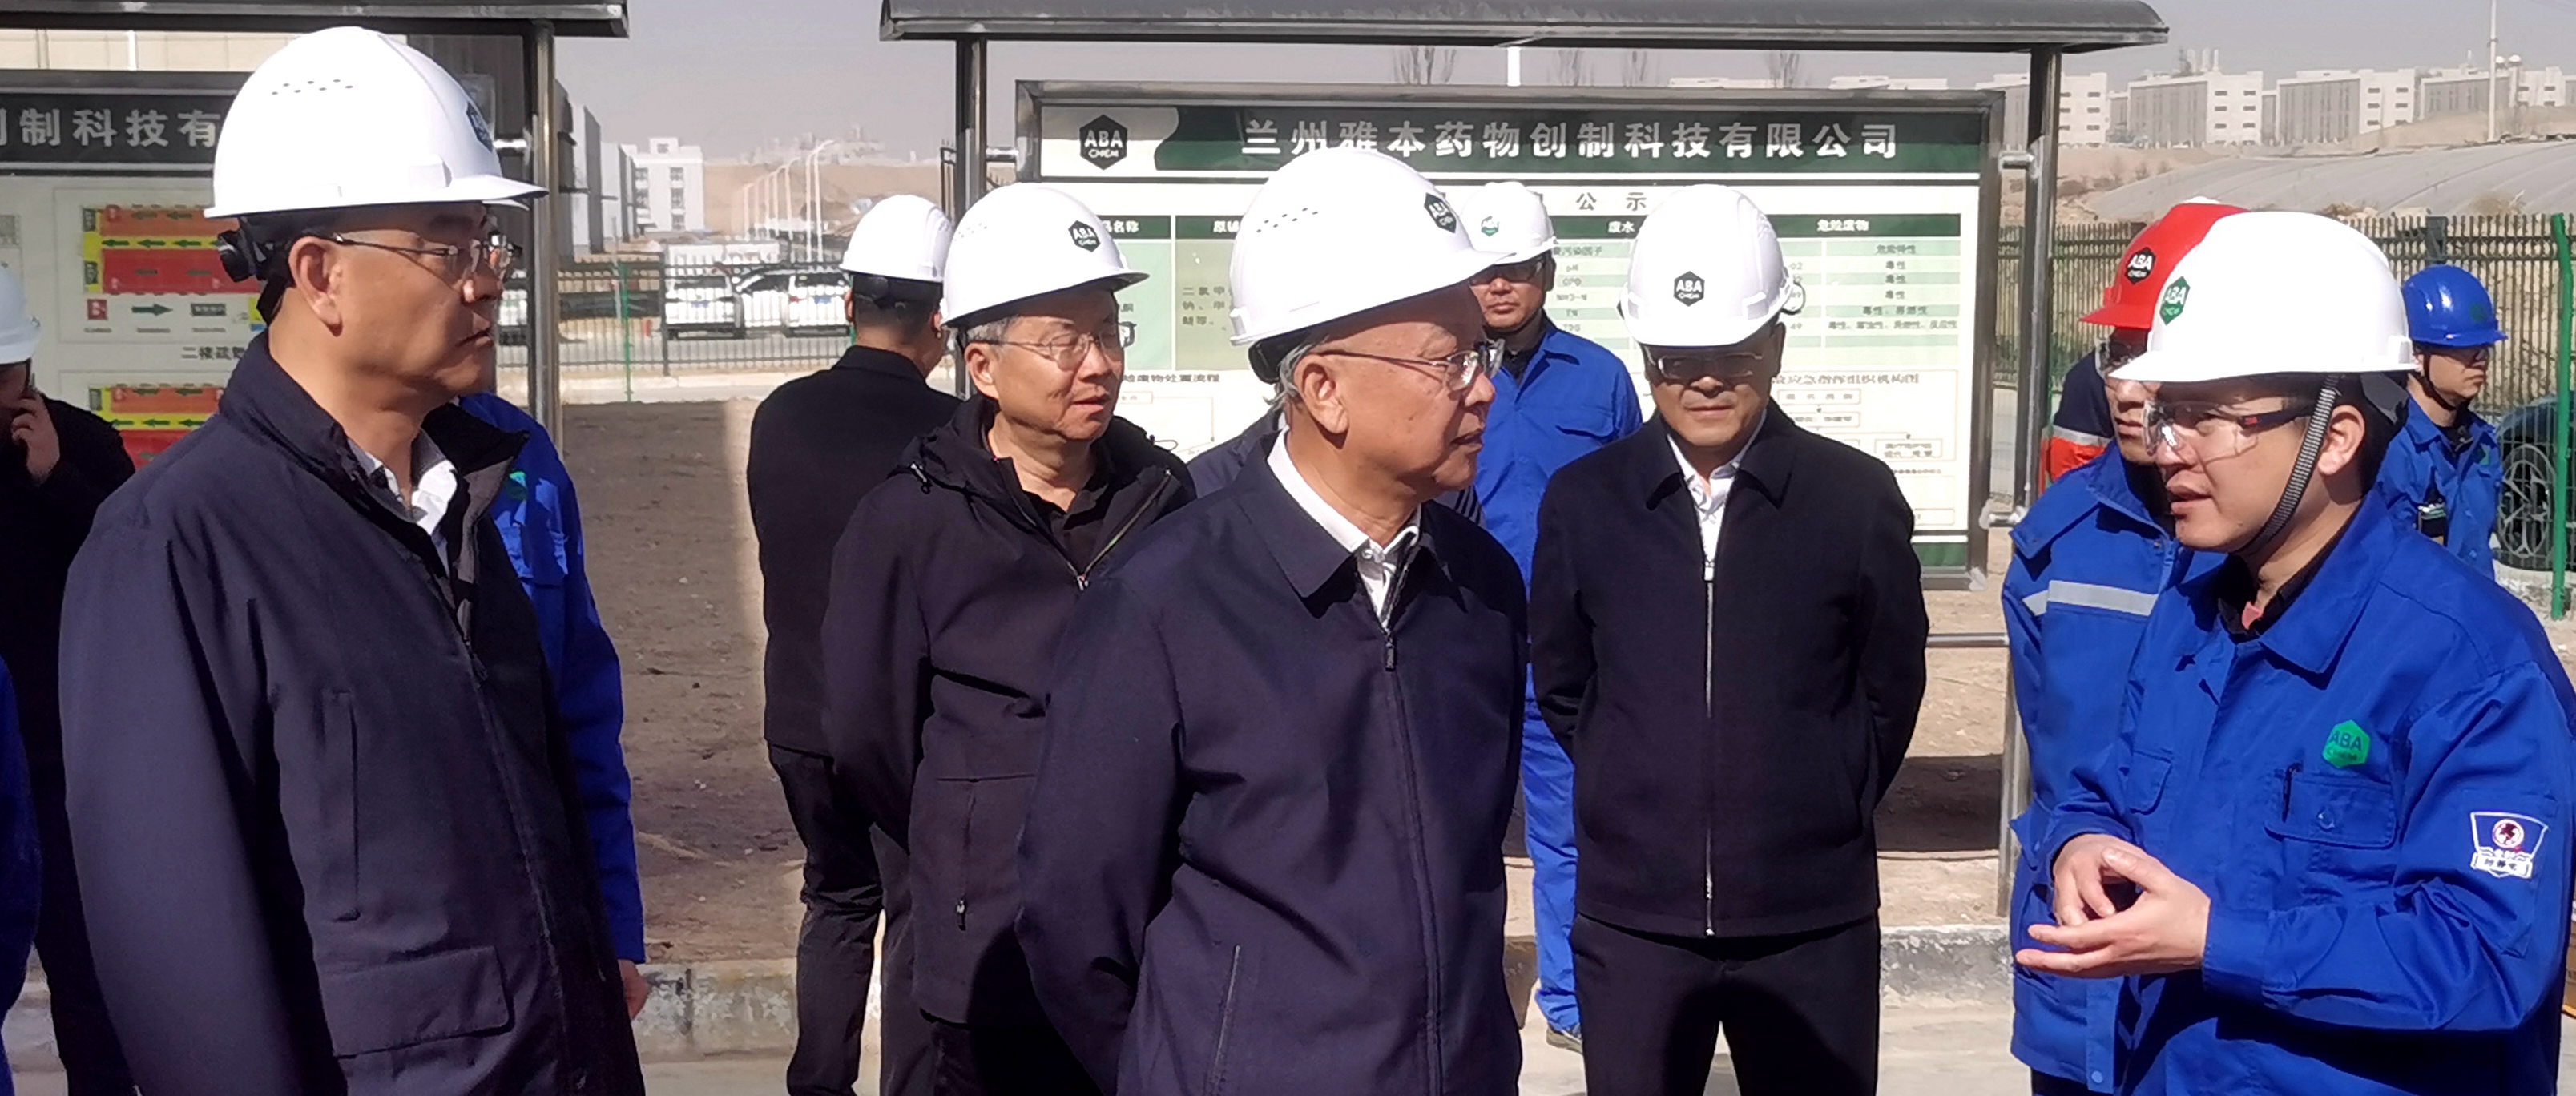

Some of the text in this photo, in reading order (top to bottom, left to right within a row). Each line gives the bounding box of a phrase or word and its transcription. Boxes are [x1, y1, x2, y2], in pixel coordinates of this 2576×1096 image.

[0, 107, 221, 147] 制科技有
[1084, 130, 1123, 148] ABA
[1242, 119, 1897, 159] 兰州雅本药物创制科技有限公司
[1088, 149, 1119, 159] CHEM
[1607, 220, 1636, 233] 废水
[2127, 253, 2154, 271] ABA
[1676, 279, 1703, 293] ABA
[2164, 285, 2187, 305] ABA
[2328, 730, 2362, 751] ABA
